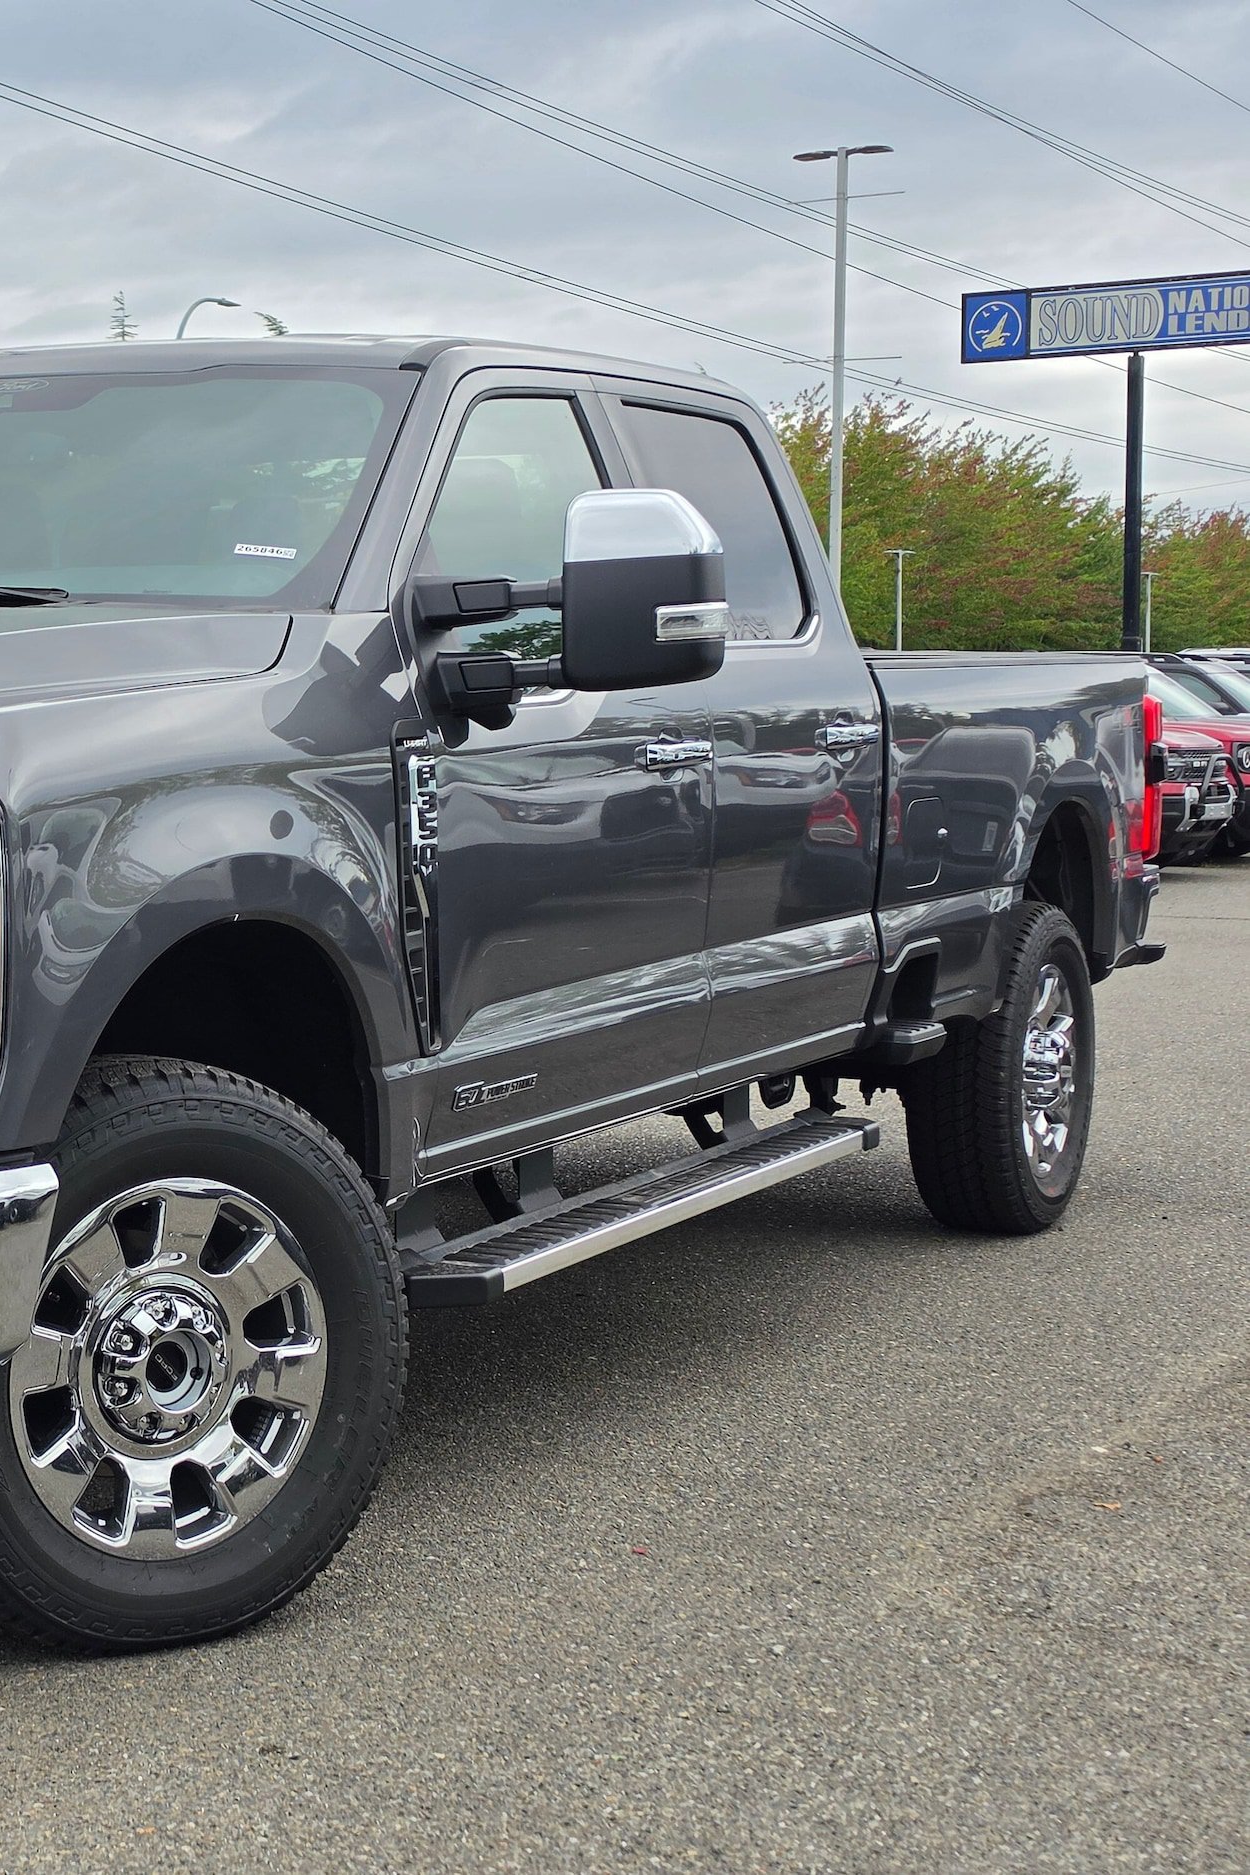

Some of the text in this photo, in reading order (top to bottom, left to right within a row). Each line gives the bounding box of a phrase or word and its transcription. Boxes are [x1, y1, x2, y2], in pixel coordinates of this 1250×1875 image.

[1168, 286, 1250, 313] NATIO
[1039, 292, 1159, 346] SOUND
[1168, 309, 1249, 336] LEND
[154, 1353, 178, 1382] FORD
